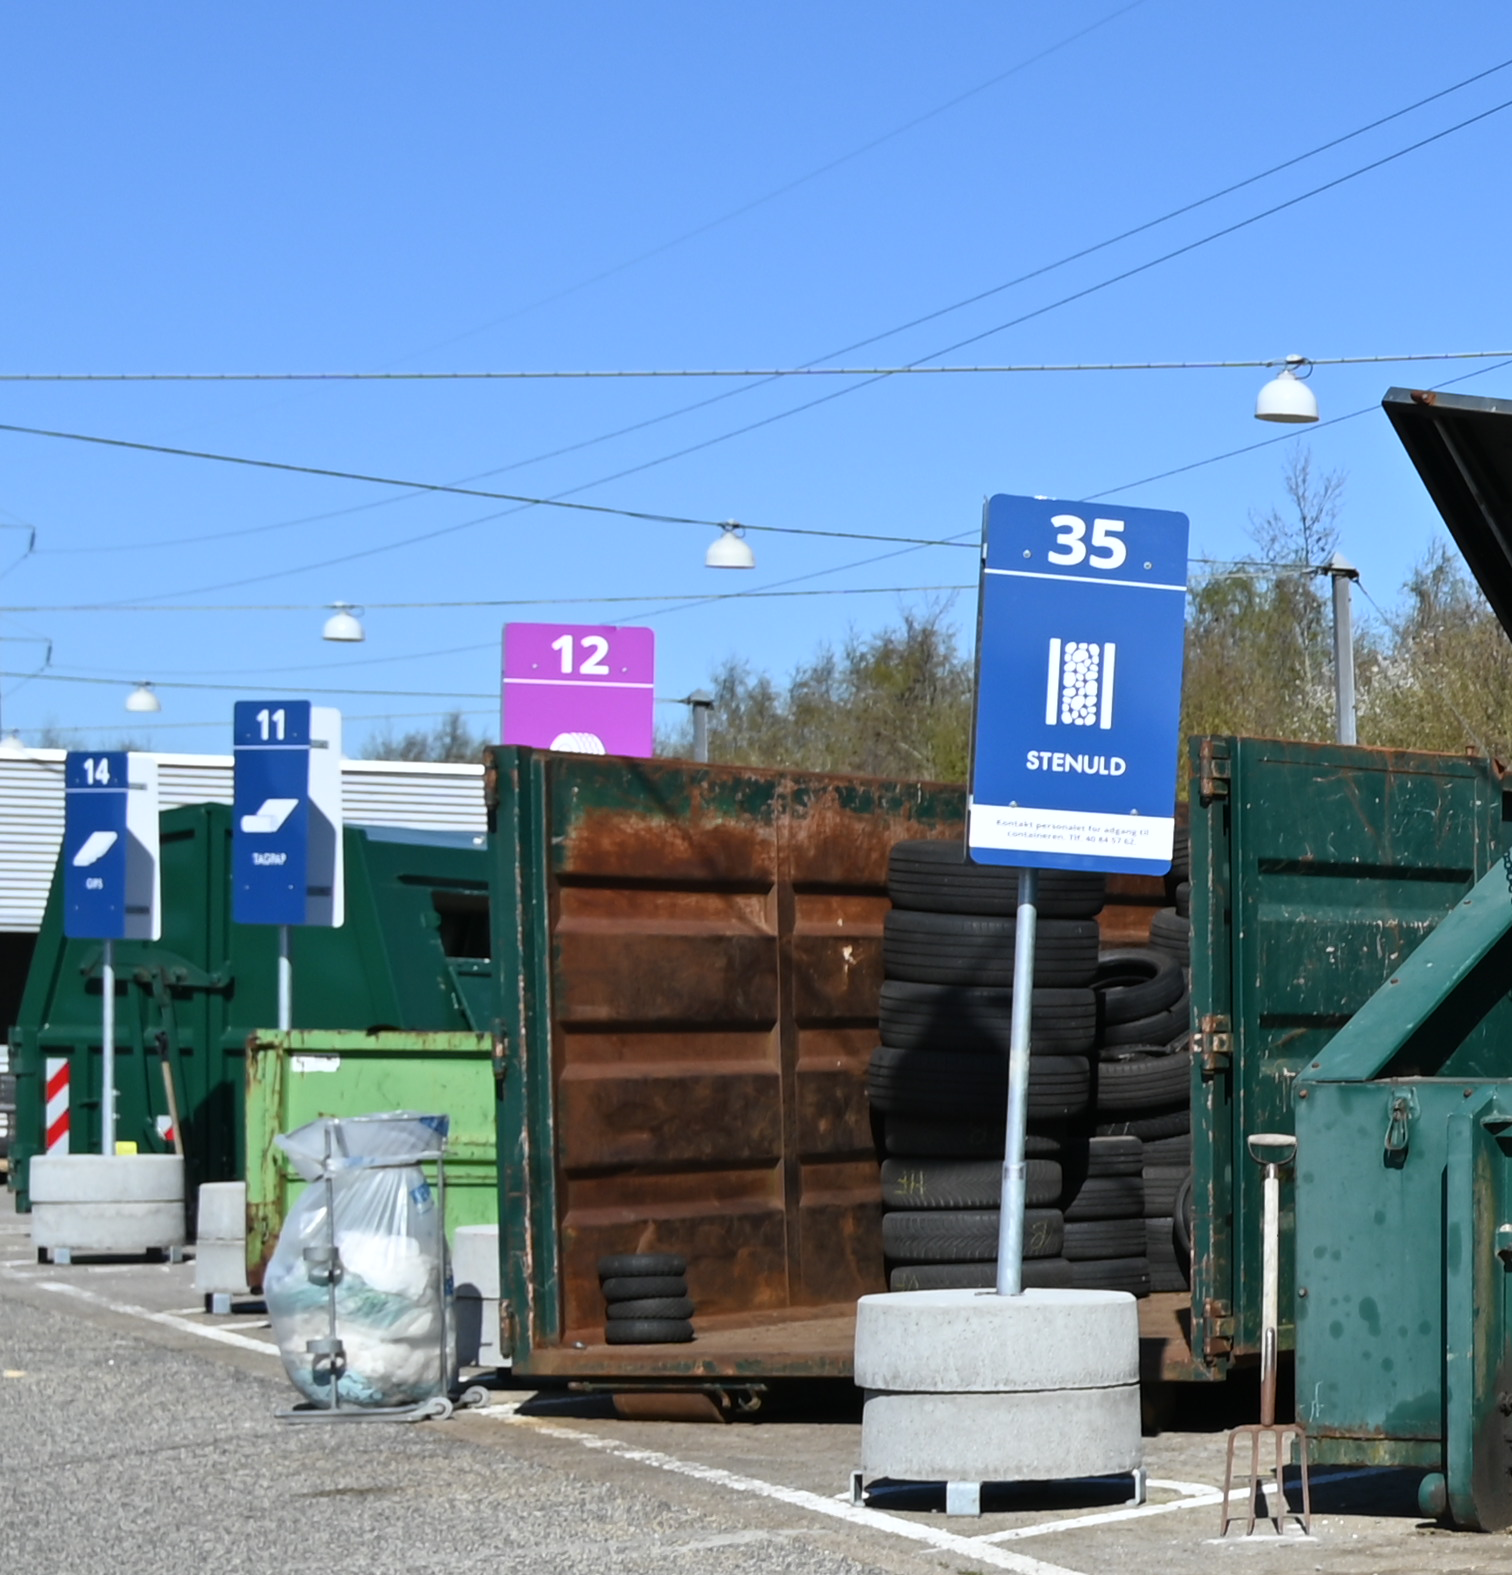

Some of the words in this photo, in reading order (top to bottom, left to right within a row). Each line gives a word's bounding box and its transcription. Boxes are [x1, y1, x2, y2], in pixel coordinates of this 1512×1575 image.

[1047, 514, 1127, 570] 35
[551, 634, 610, 675] 12
[256, 708, 285, 741] 11
[83, 757, 110, 785] 14
[1025, 750, 1127, 776] STENULD
